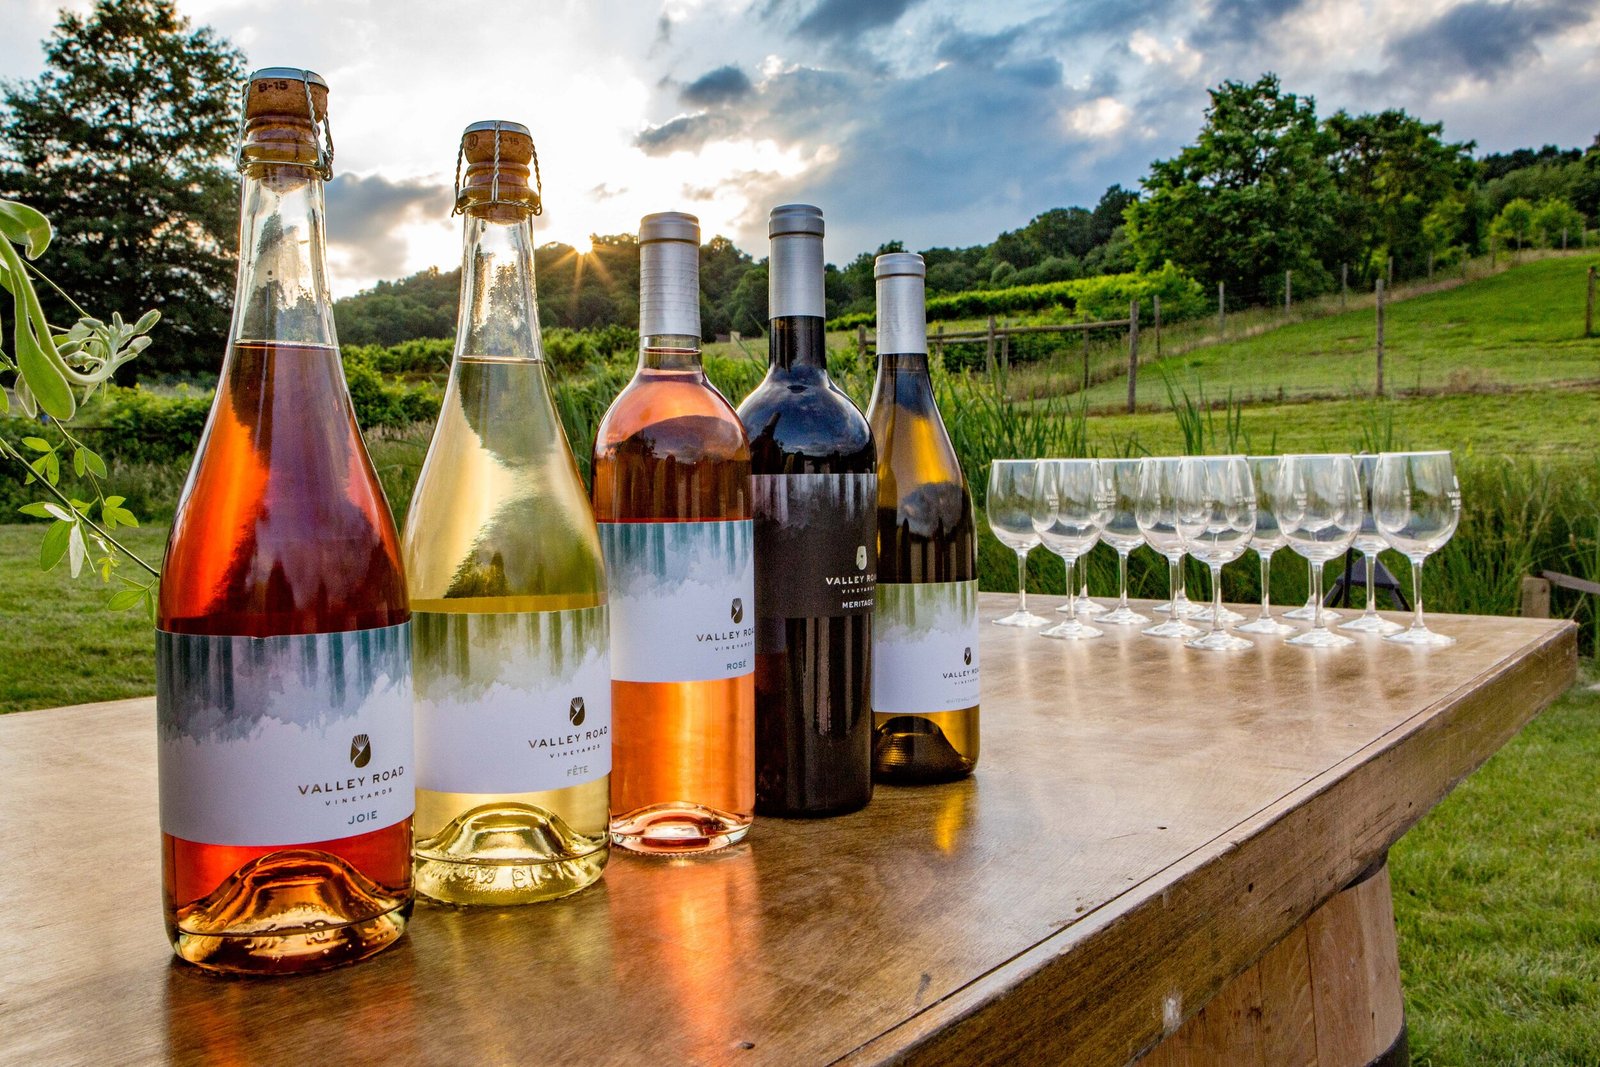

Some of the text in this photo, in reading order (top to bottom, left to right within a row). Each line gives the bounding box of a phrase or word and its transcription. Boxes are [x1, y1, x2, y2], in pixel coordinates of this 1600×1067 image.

[825, 575, 864, 585] VALLEY
[842, 598, 874, 609] MERITAGE
[696, 627, 754, 642] VALLEY ROA
[942, 670, 971, 679] VALLEY
[528, 725, 608, 749] VALLEY ROAD
[549, 743, 601, 759] VINEYARDS
[566, 764, 589, 777] FÊTE
[298, 766, 404, 796] VALLEY ROAD
[325, 787, 393, 807] VINEYARDS
[347, 810, 378, 825] JOIE
